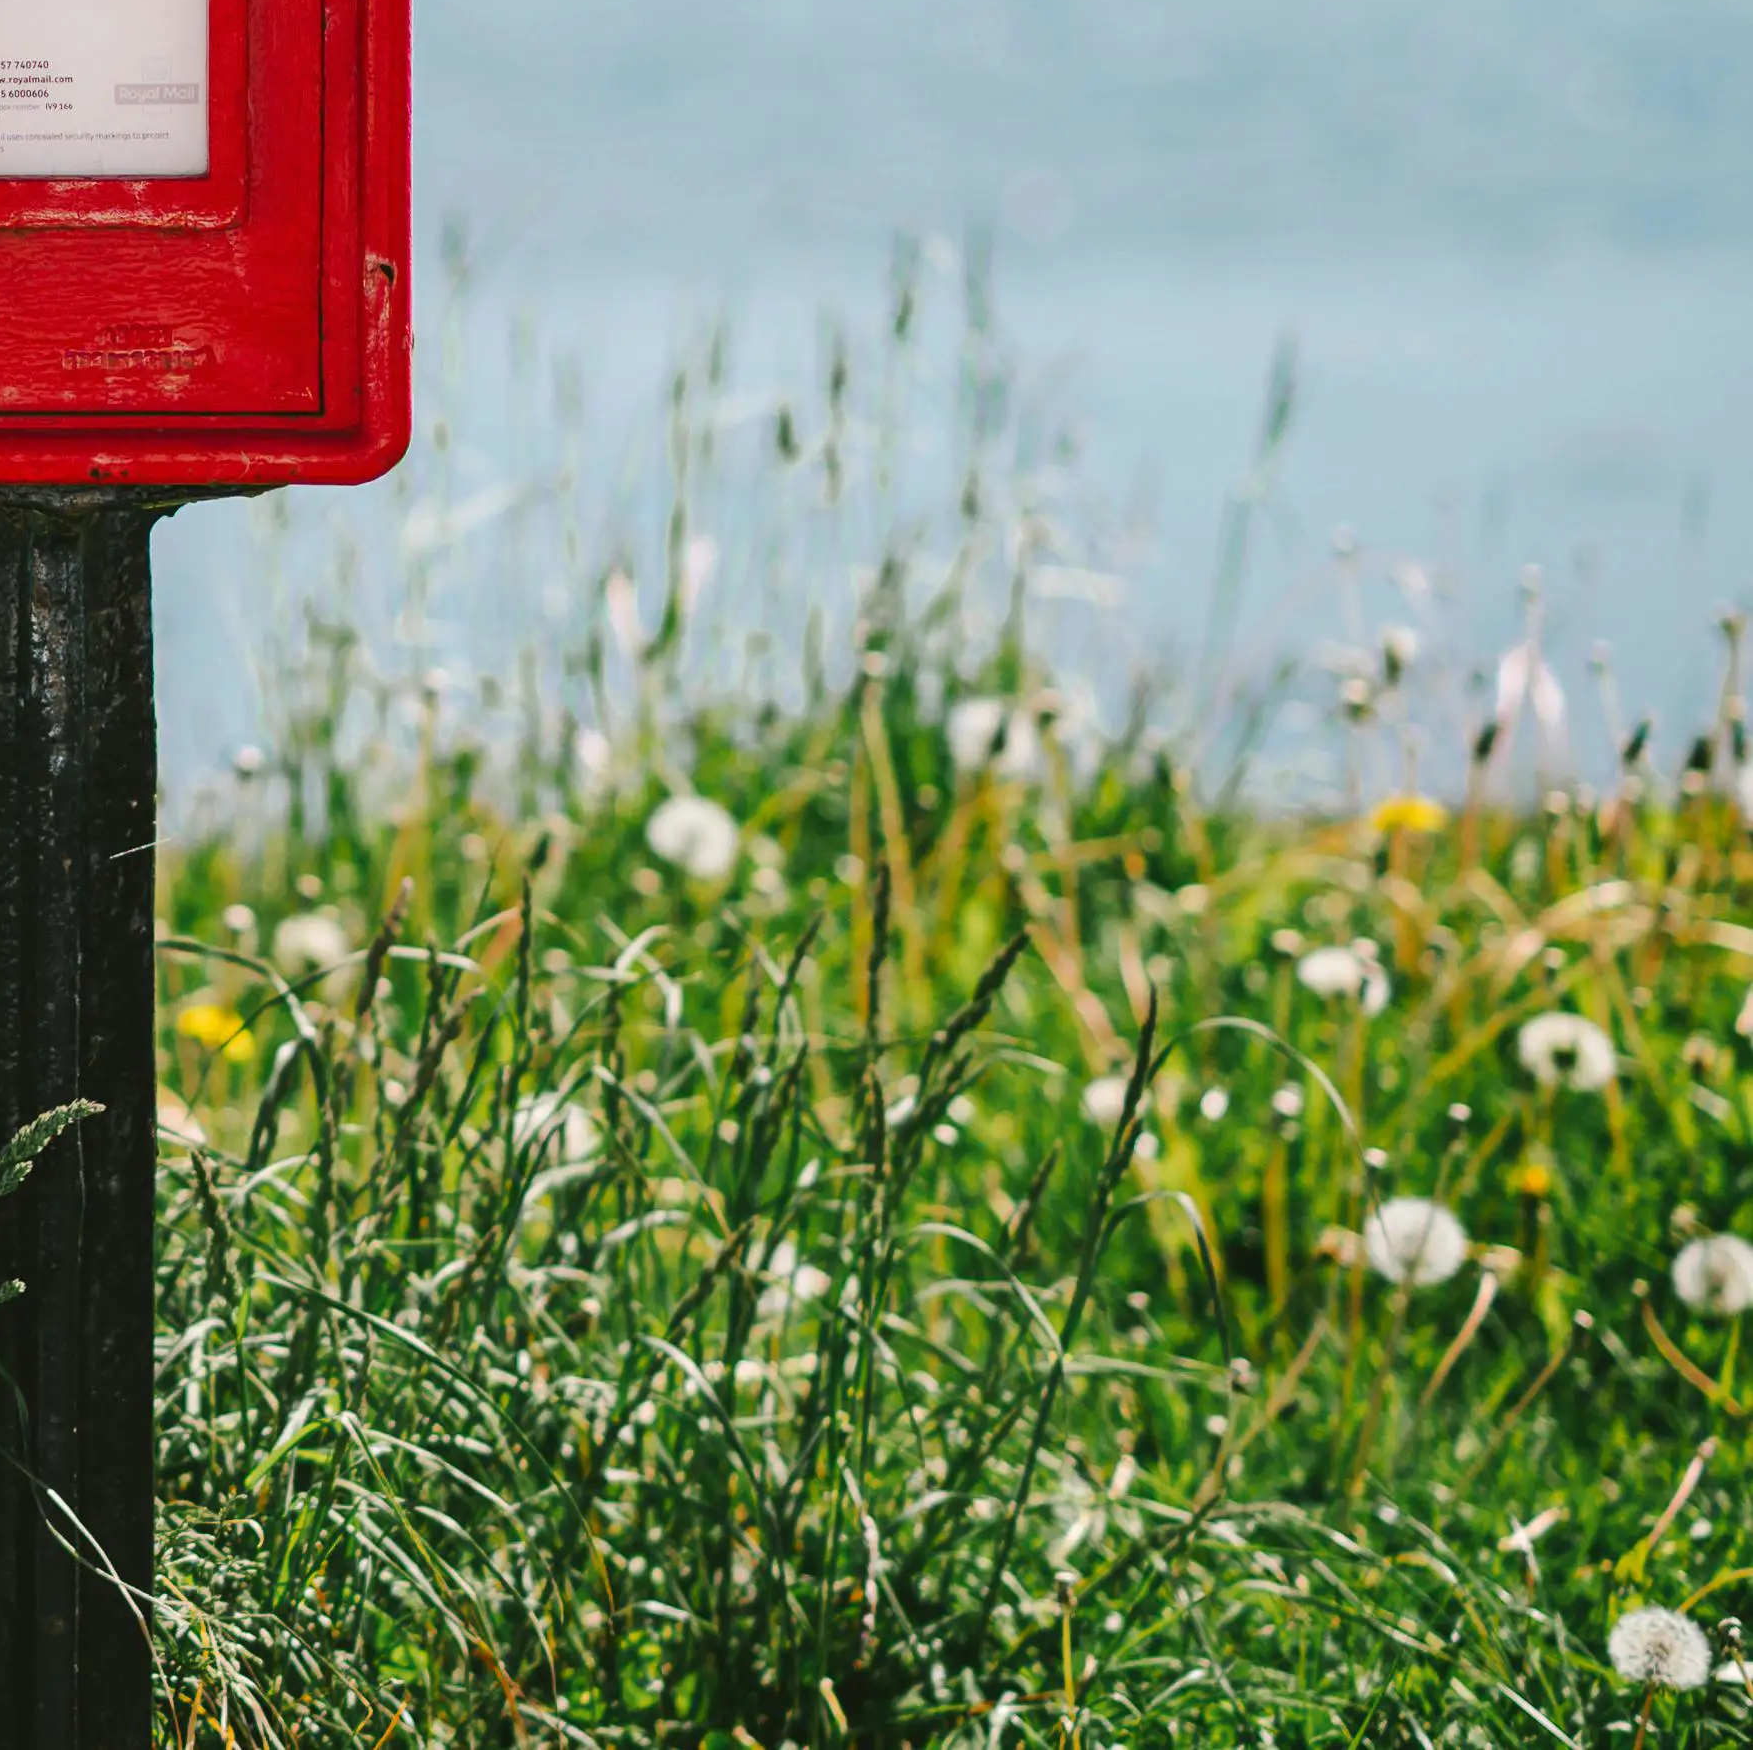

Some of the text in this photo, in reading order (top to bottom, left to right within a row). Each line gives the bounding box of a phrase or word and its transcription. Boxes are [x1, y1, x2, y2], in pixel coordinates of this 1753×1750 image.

[14, 60, 49, 69] 740740
[9, 89, 49, 98] 6000606
[119, 86, 195, 103] Royal Mail
[45, 102, 58, 111] IV9
